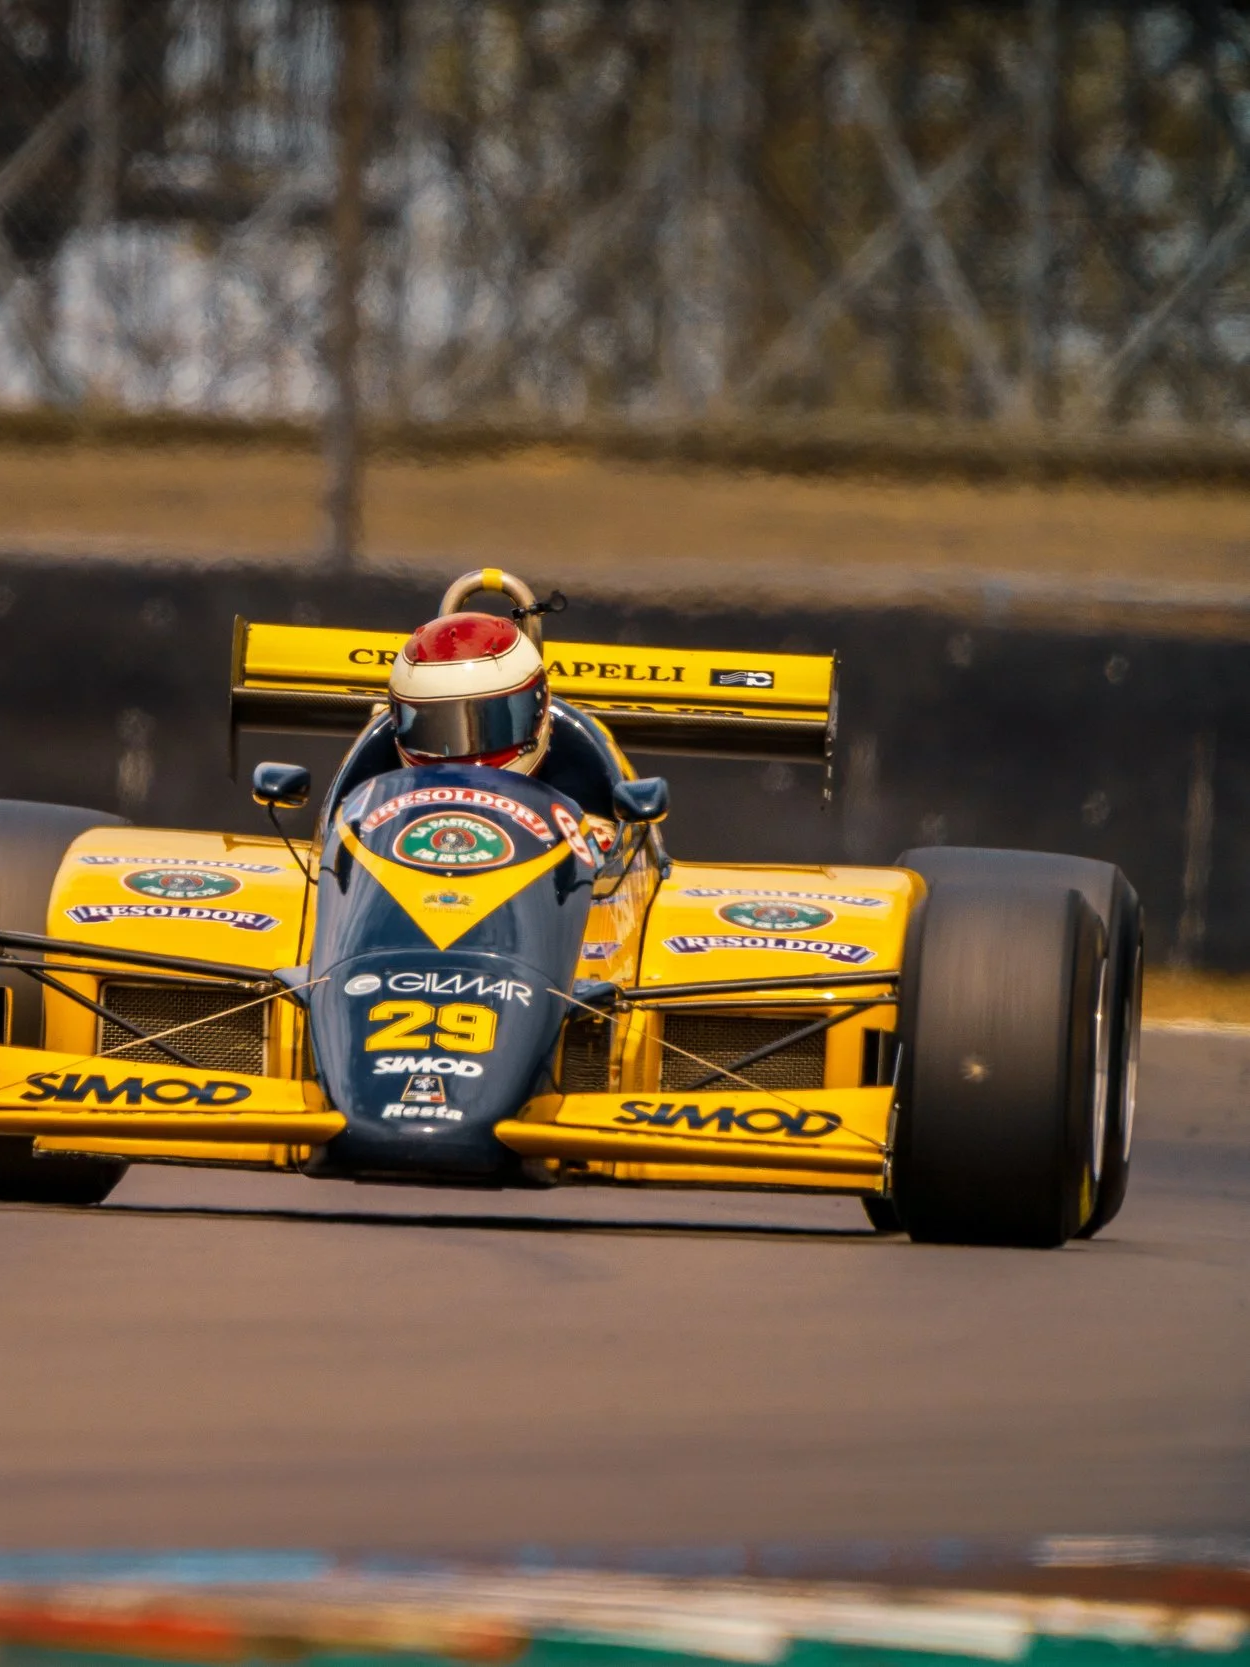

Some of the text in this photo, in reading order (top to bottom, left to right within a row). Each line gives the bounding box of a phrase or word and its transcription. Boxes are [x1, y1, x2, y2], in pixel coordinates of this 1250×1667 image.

[547, 660, 686, 682] APELLI
[376, 789, 535, 823] RESOLDOR
[88, 905, 257, 926] RESOLDOR
[683, 936, 853, 956] RESOLDOR
[388, 972, 532, 1007] GILMAR
[364, 999, 498, 1054] 29
[372, 1056, 484, 1078] SIMOD
[19, 1072, 252, 1106] SIMOD
[612, 1100, 843, 1137] SIMOD
